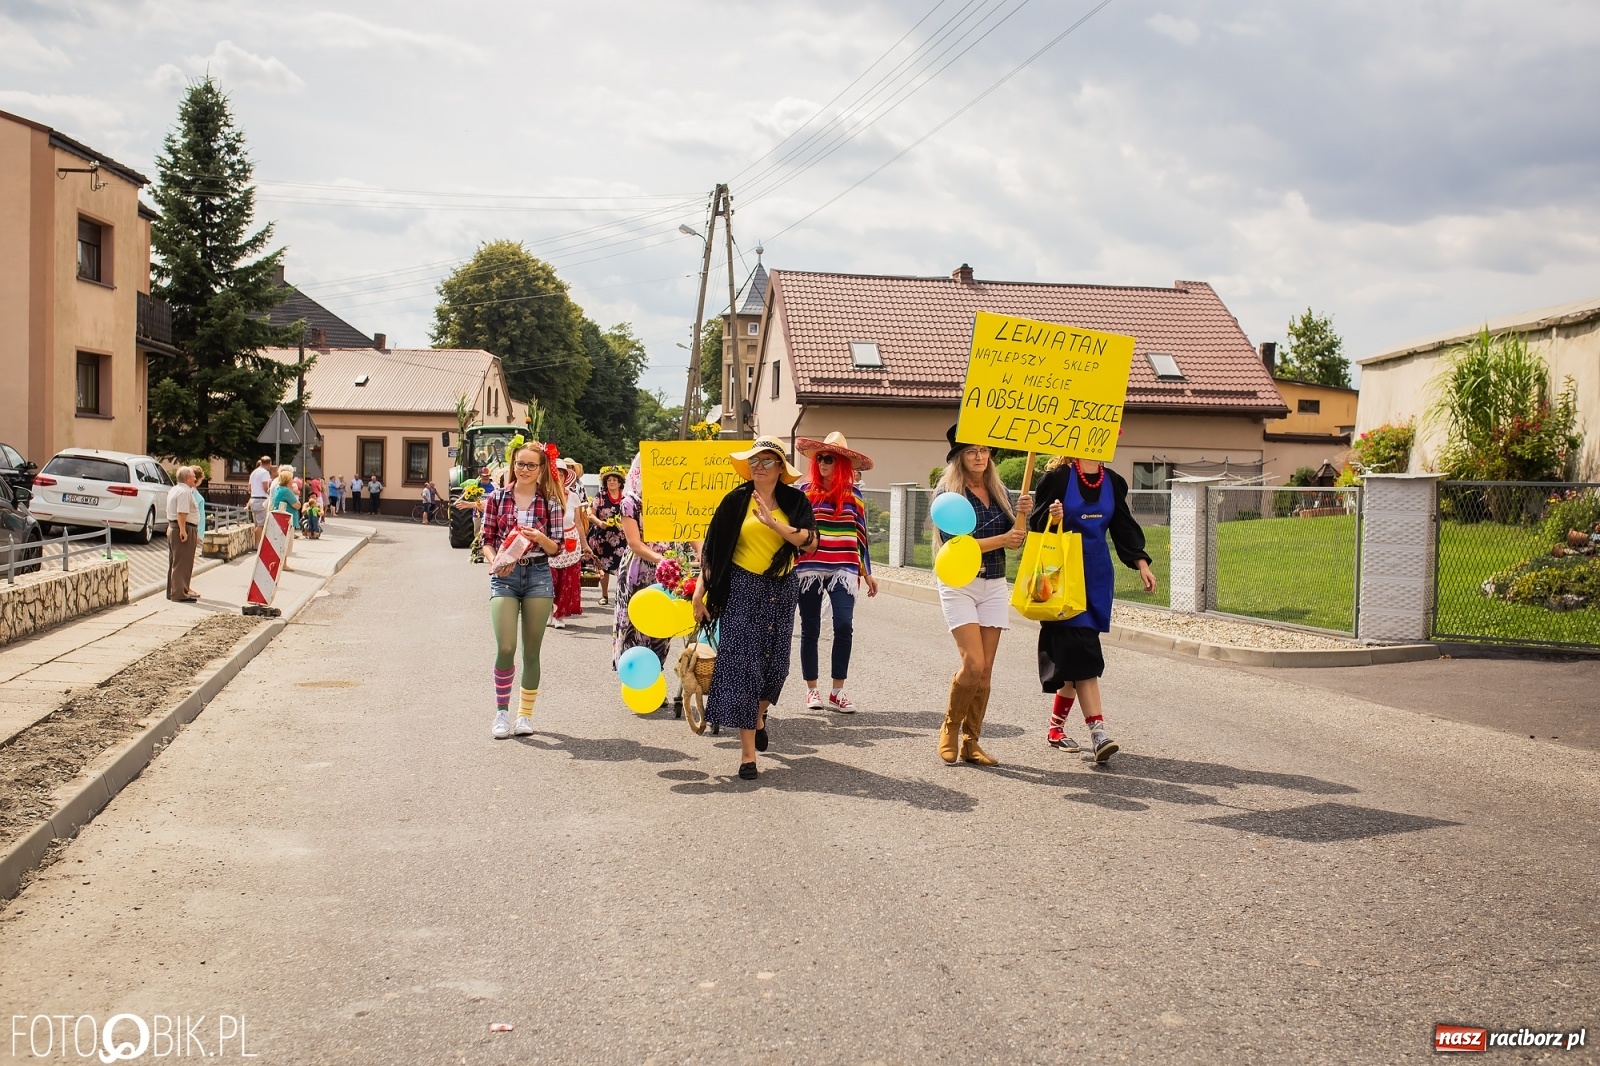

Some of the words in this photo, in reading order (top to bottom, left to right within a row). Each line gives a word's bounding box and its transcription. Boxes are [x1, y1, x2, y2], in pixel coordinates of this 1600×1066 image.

[994, 321, 1108, 356] LEWIATAN
[975, 347, 1047, 367] NAJLEPSZY
[1063, 359, 1100, 373] SKLEP
[1002, 373, 1014, 385] W
[1023, 373, 1073, 391] MIEŚCIE
[967, 387, 981, 408] A
[986, 388, 1059, 415] OBSŁUGA
[1063, 398, 1123, 423] JESZCZE
[988, 415, 1081, 450] LEPSZA
[651, 449, 688, 466] Rzecz
[646, 500, 677, 523] każdy
[686, 501, 715, 516] każd
[673, 523, 710, 540] DOST
